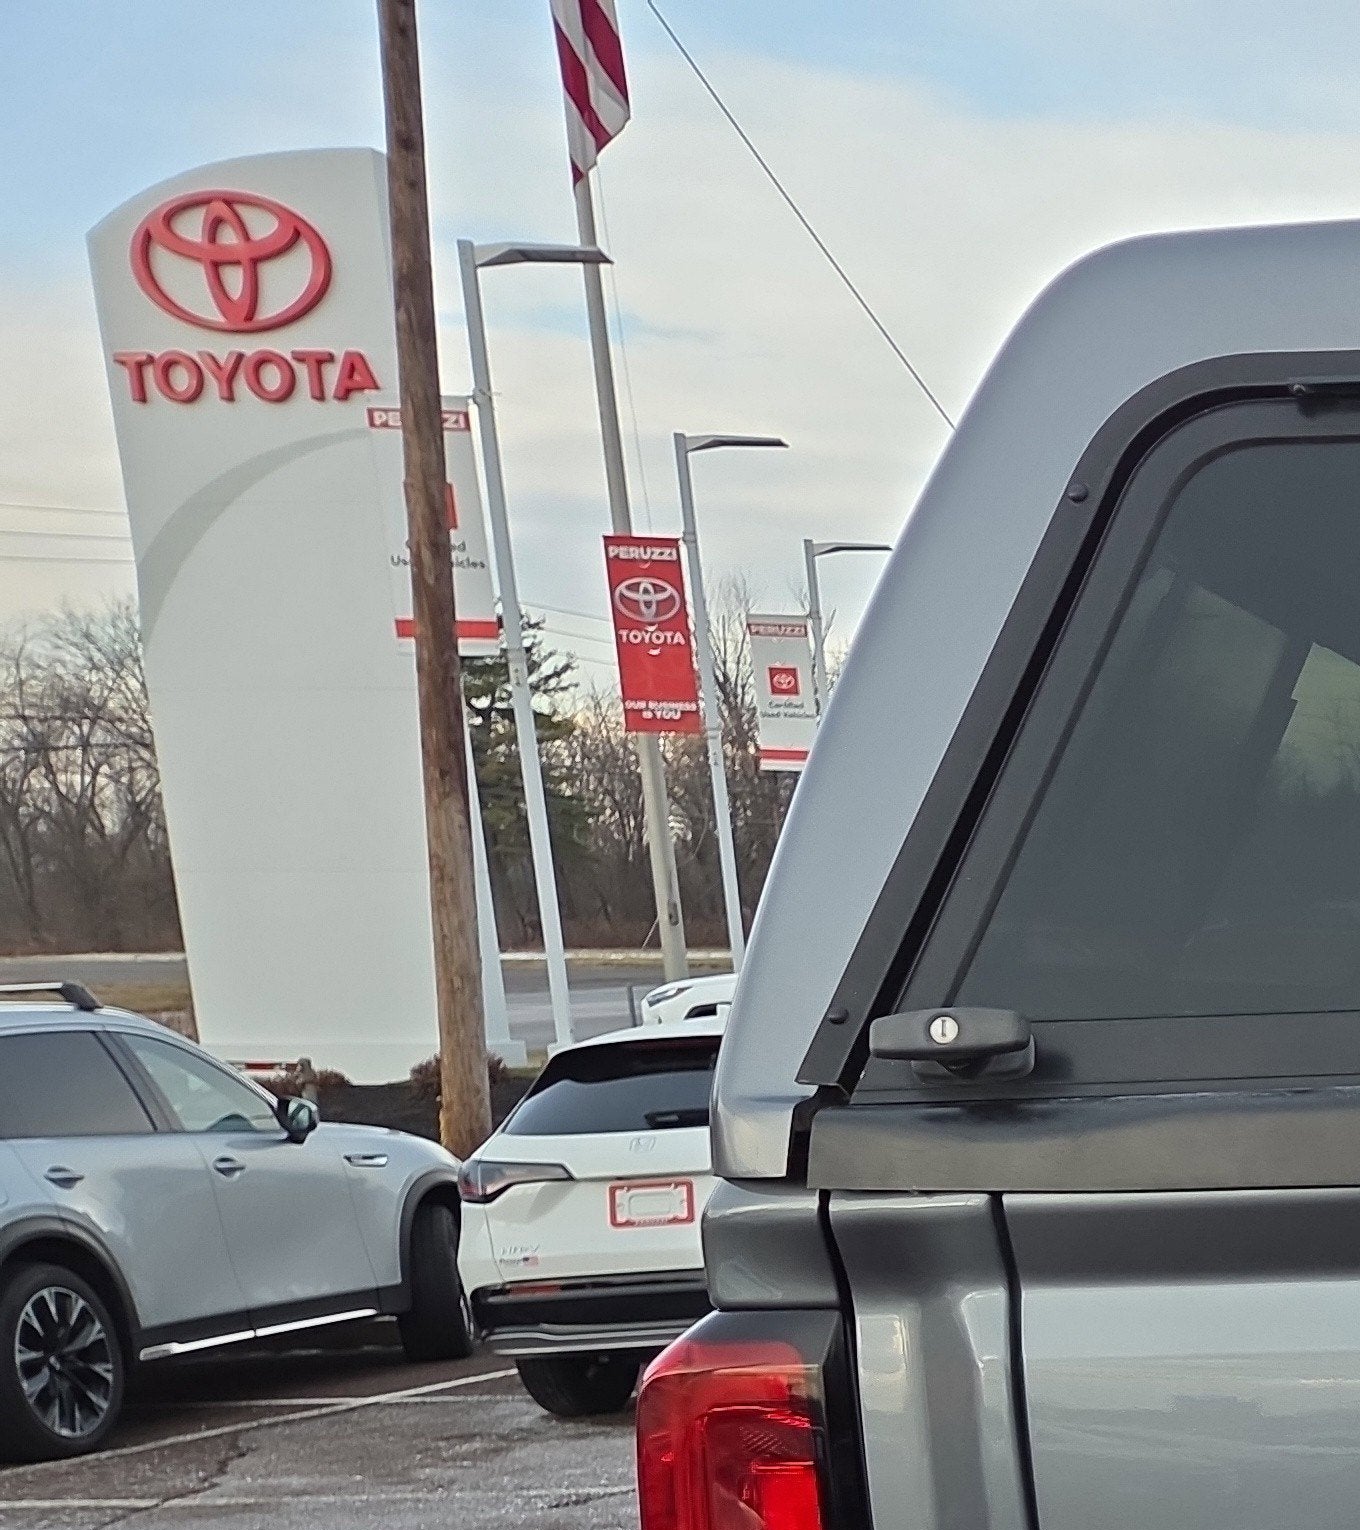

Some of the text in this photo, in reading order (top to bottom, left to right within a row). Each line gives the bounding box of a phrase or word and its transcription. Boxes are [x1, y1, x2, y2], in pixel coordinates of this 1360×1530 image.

[113, 350, 380, 404] TOYOTA
[372, 411, 466, 430] PEZI
[608, 545, 678, 562] PERUZZI
[618, 628, 686, 646] TOYOTA
